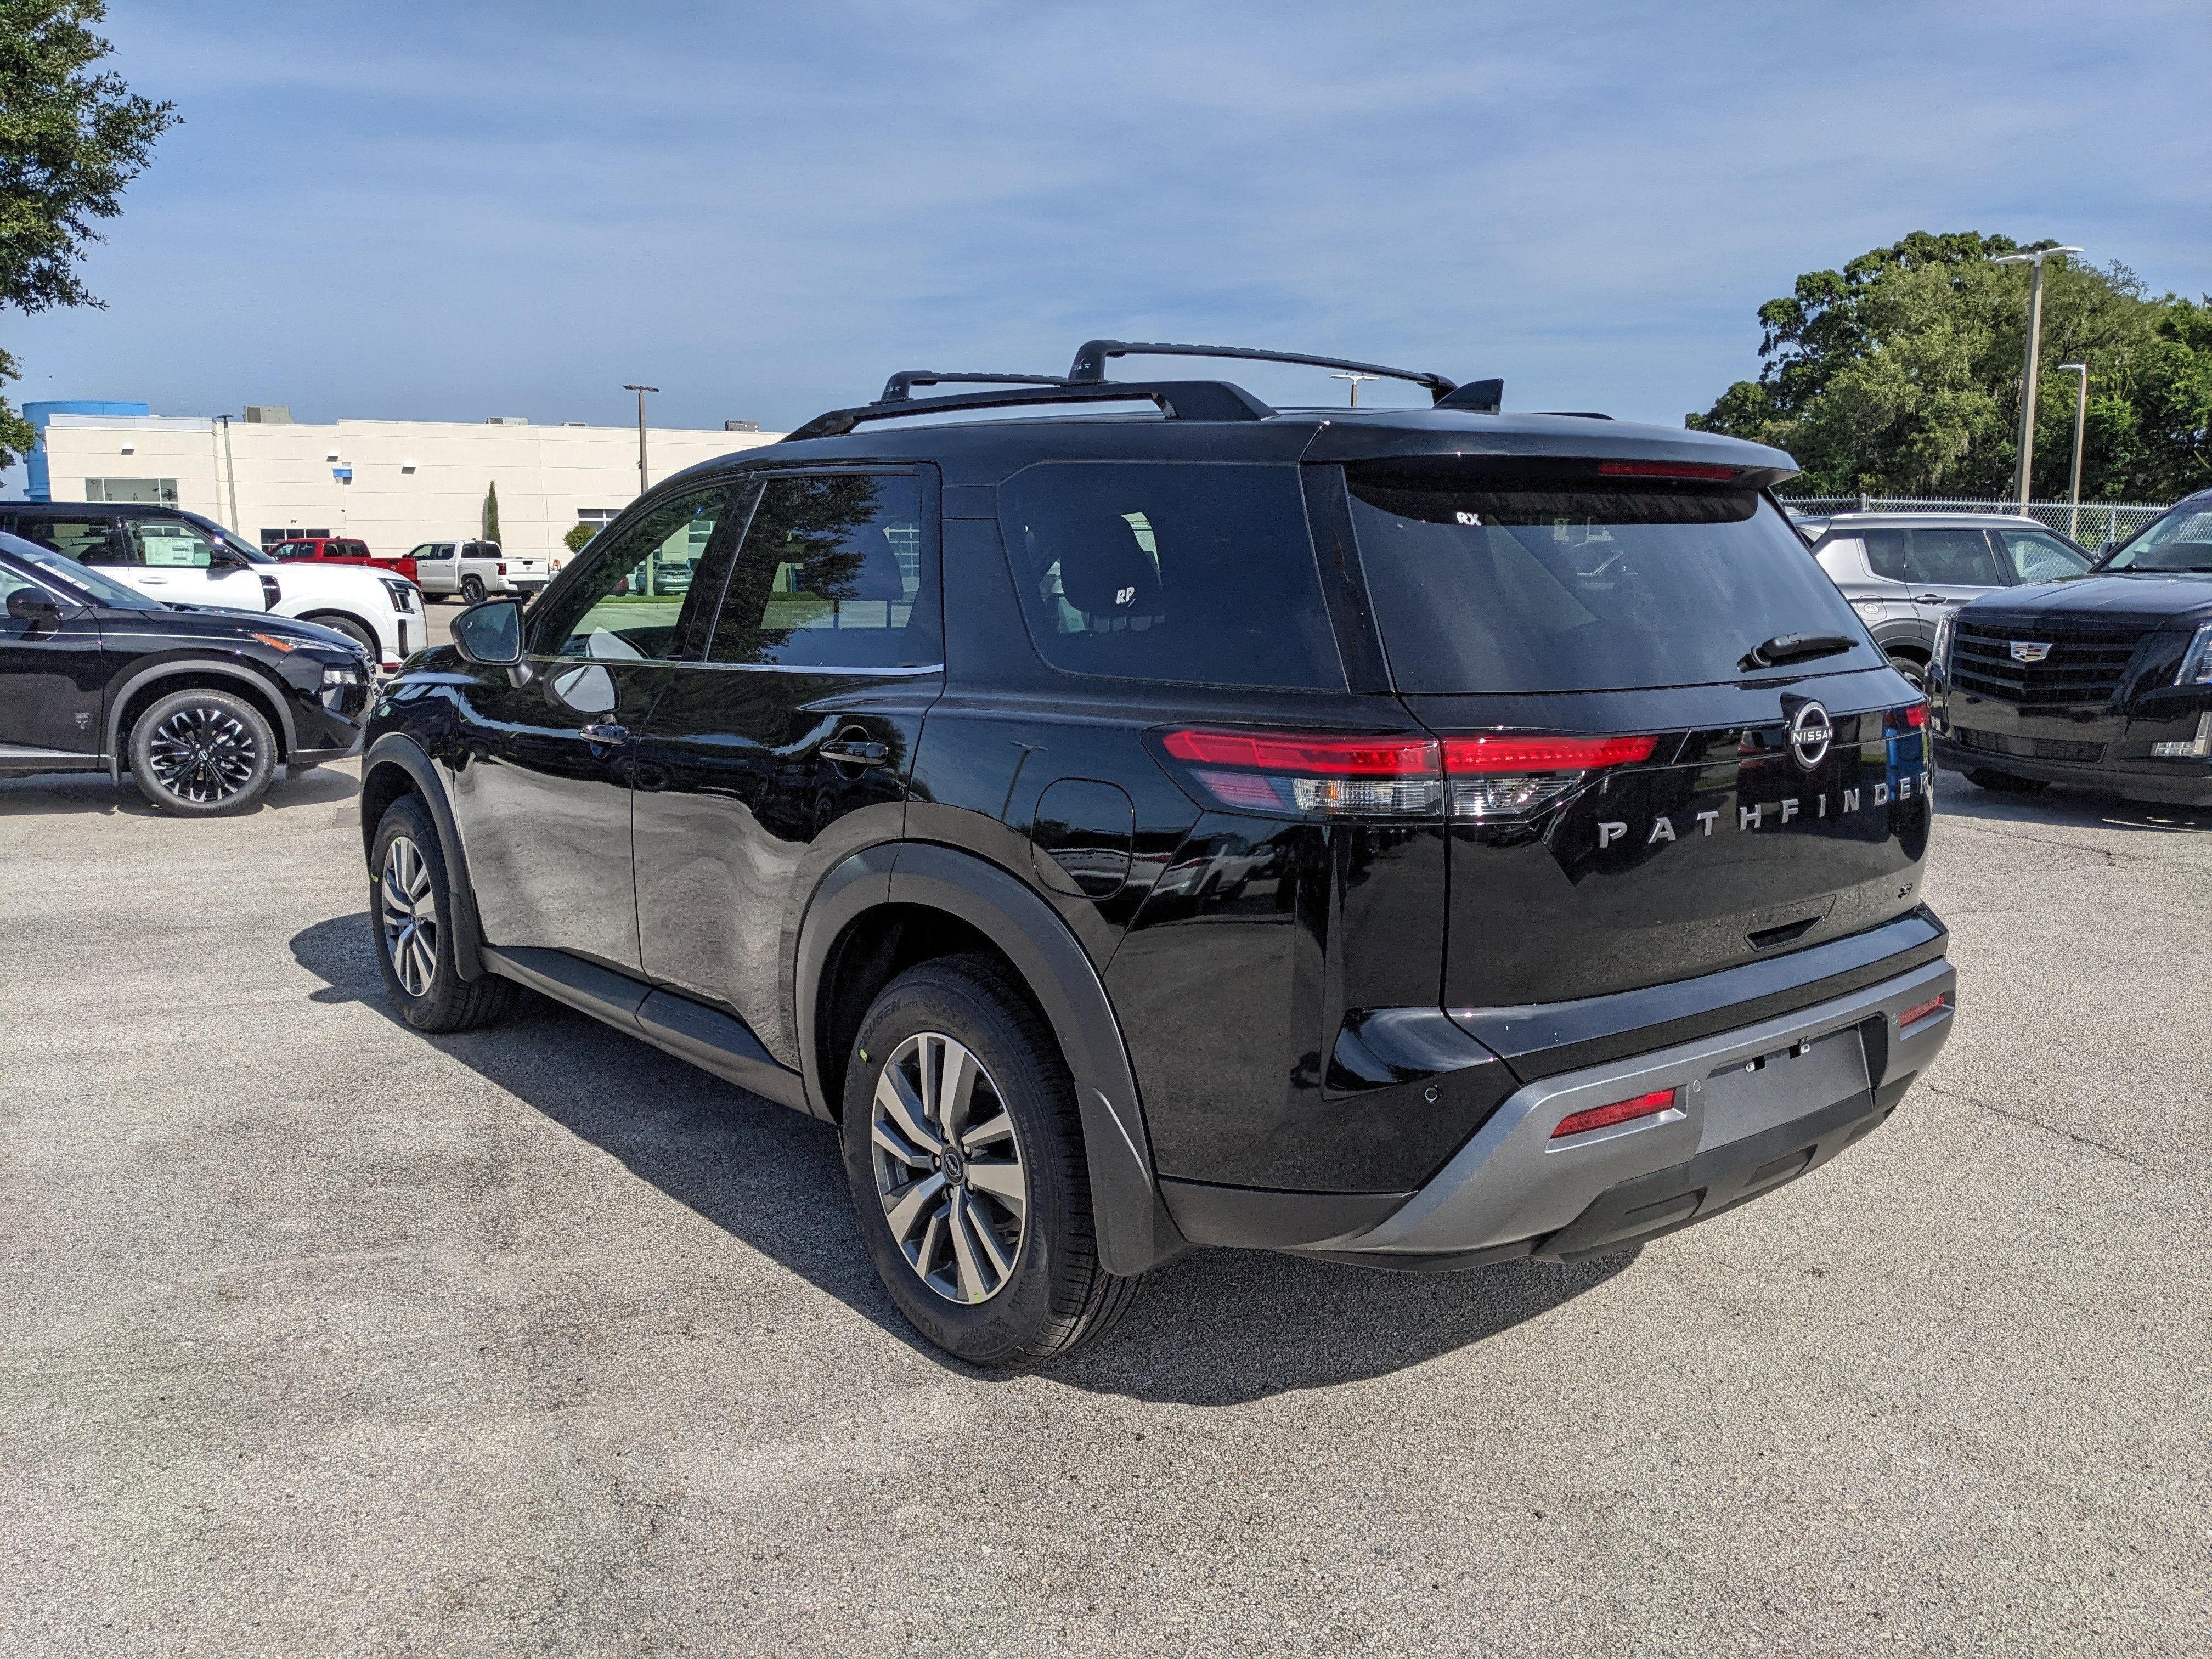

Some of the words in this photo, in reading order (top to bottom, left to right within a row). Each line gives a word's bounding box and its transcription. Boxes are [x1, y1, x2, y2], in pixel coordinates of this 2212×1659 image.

[1456, 512, 1482, 526] RX
[1116, 586, 1135, 605] RP
[1792, 729, 1833, 742] NISSAN
[1597, 771, 1929, 849] PATHFINDER
